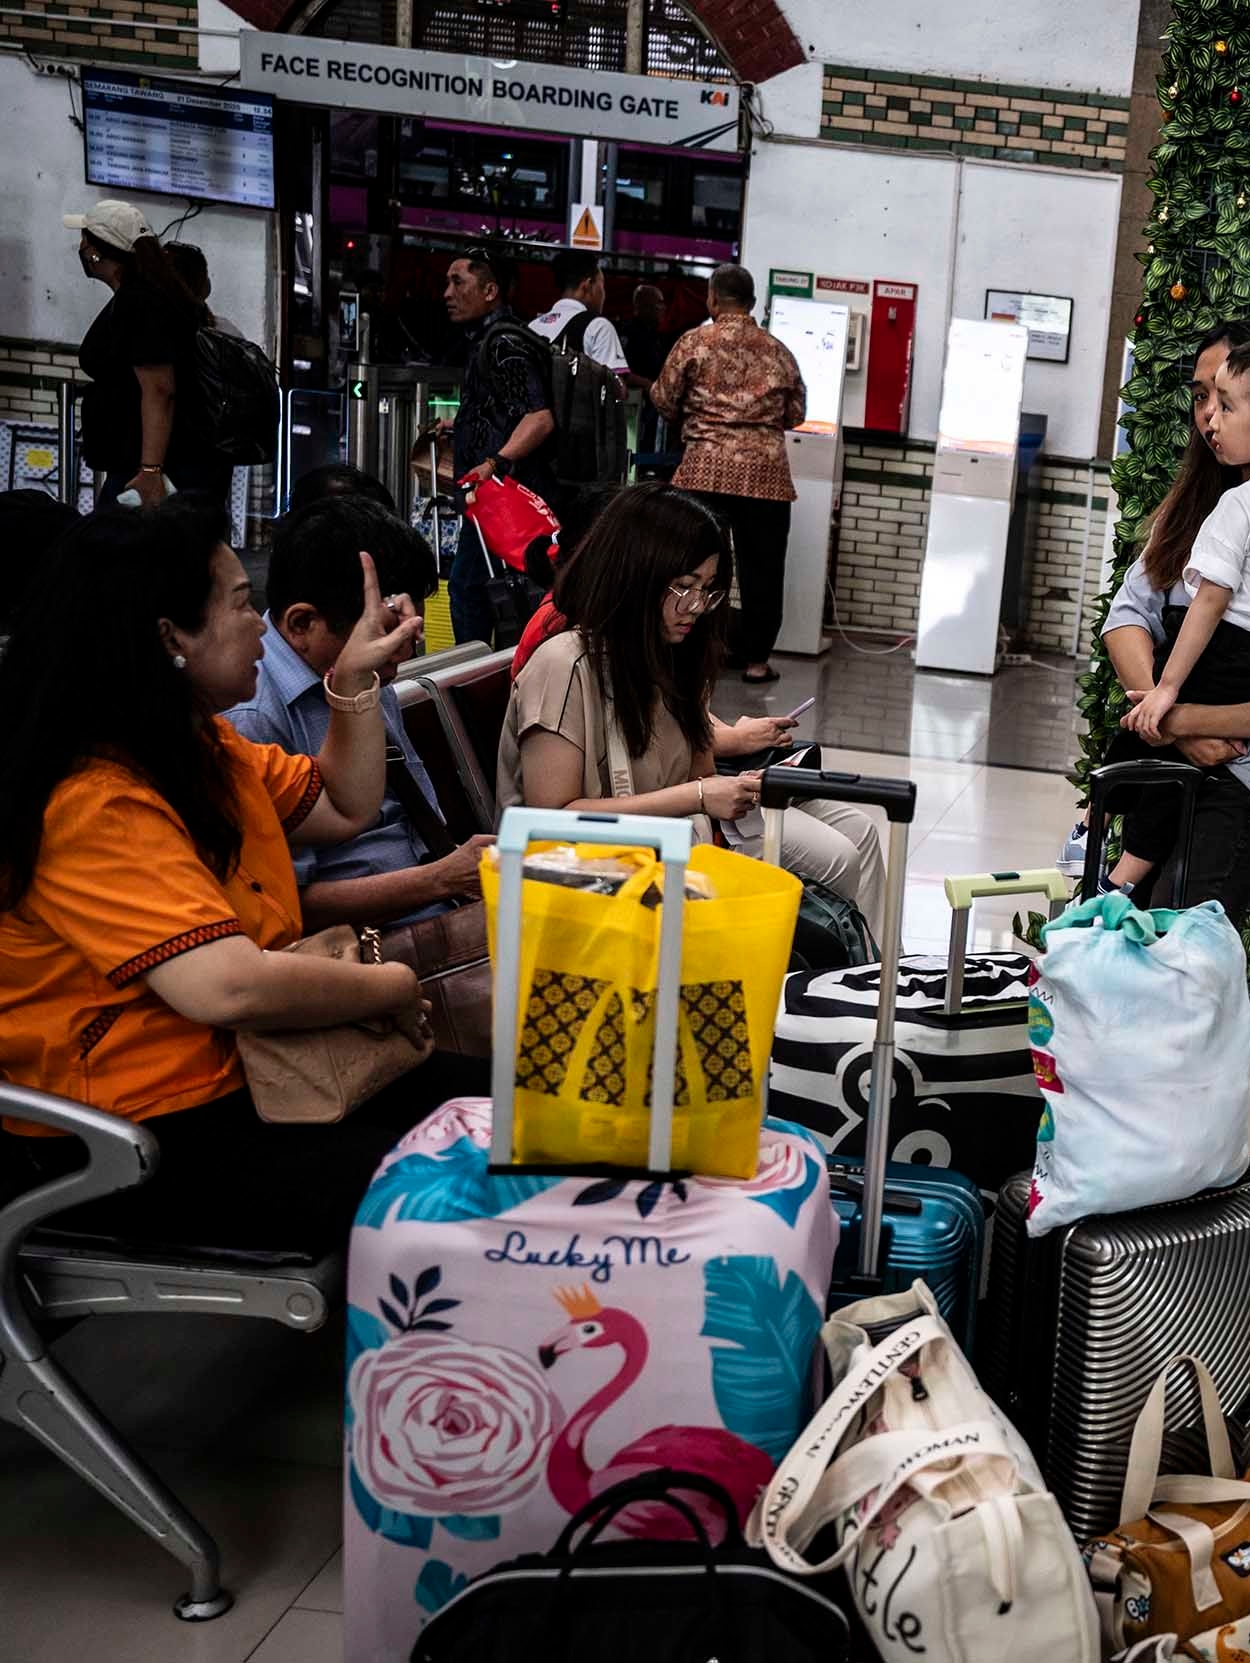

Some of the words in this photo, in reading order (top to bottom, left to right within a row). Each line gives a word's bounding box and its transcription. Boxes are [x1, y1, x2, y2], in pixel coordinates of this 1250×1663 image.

[260, 53, 320, 77] FACE
[326, 60, 484, 97] RECOGNITION
[492, 79, 612, 111] BOARDING
[619, 95, 679, 119] GATE
[884, 286, 907, 297] APAR
[484, 1230, 614, 1284] Lucky
[603, 1235, 692, 1267] Me
